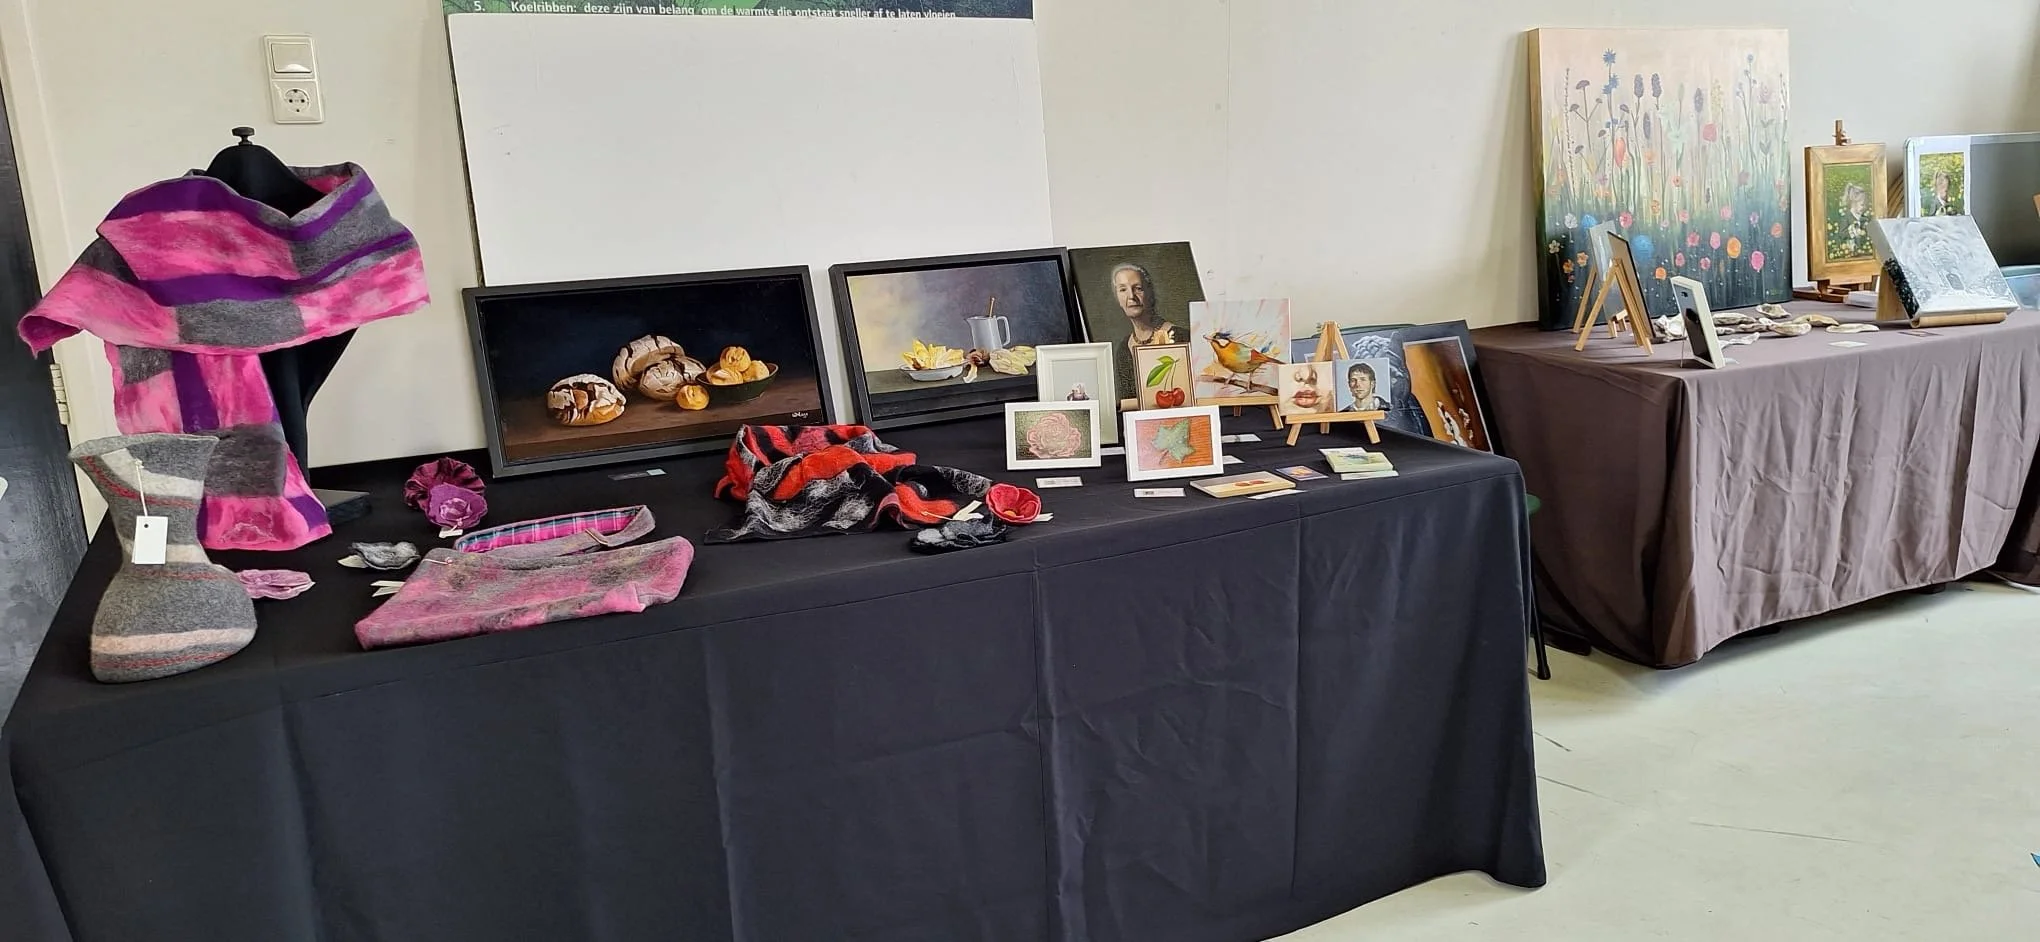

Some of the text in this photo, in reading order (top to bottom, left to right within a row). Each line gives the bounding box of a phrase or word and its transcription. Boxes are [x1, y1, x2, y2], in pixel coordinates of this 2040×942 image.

[474, 1, 485, 12] 5.
[511, 1, 577, 13] Koelribben:
[583, 3, 610, 13] deze
[613, 4, 633, 14] zijn
[636, 6, 656, 14] van
[720, 6, 734, 16] de
[736, 7, 774, 16] warmte
[777, 7, 793, 16] die
[795, 8, 836, 17] ontstaat
[839, 8, 871, 18] sneller
[873, 8, 884, 18] af
[885, 9, 896, 18] te
[898, 8, 921, 18] laten
